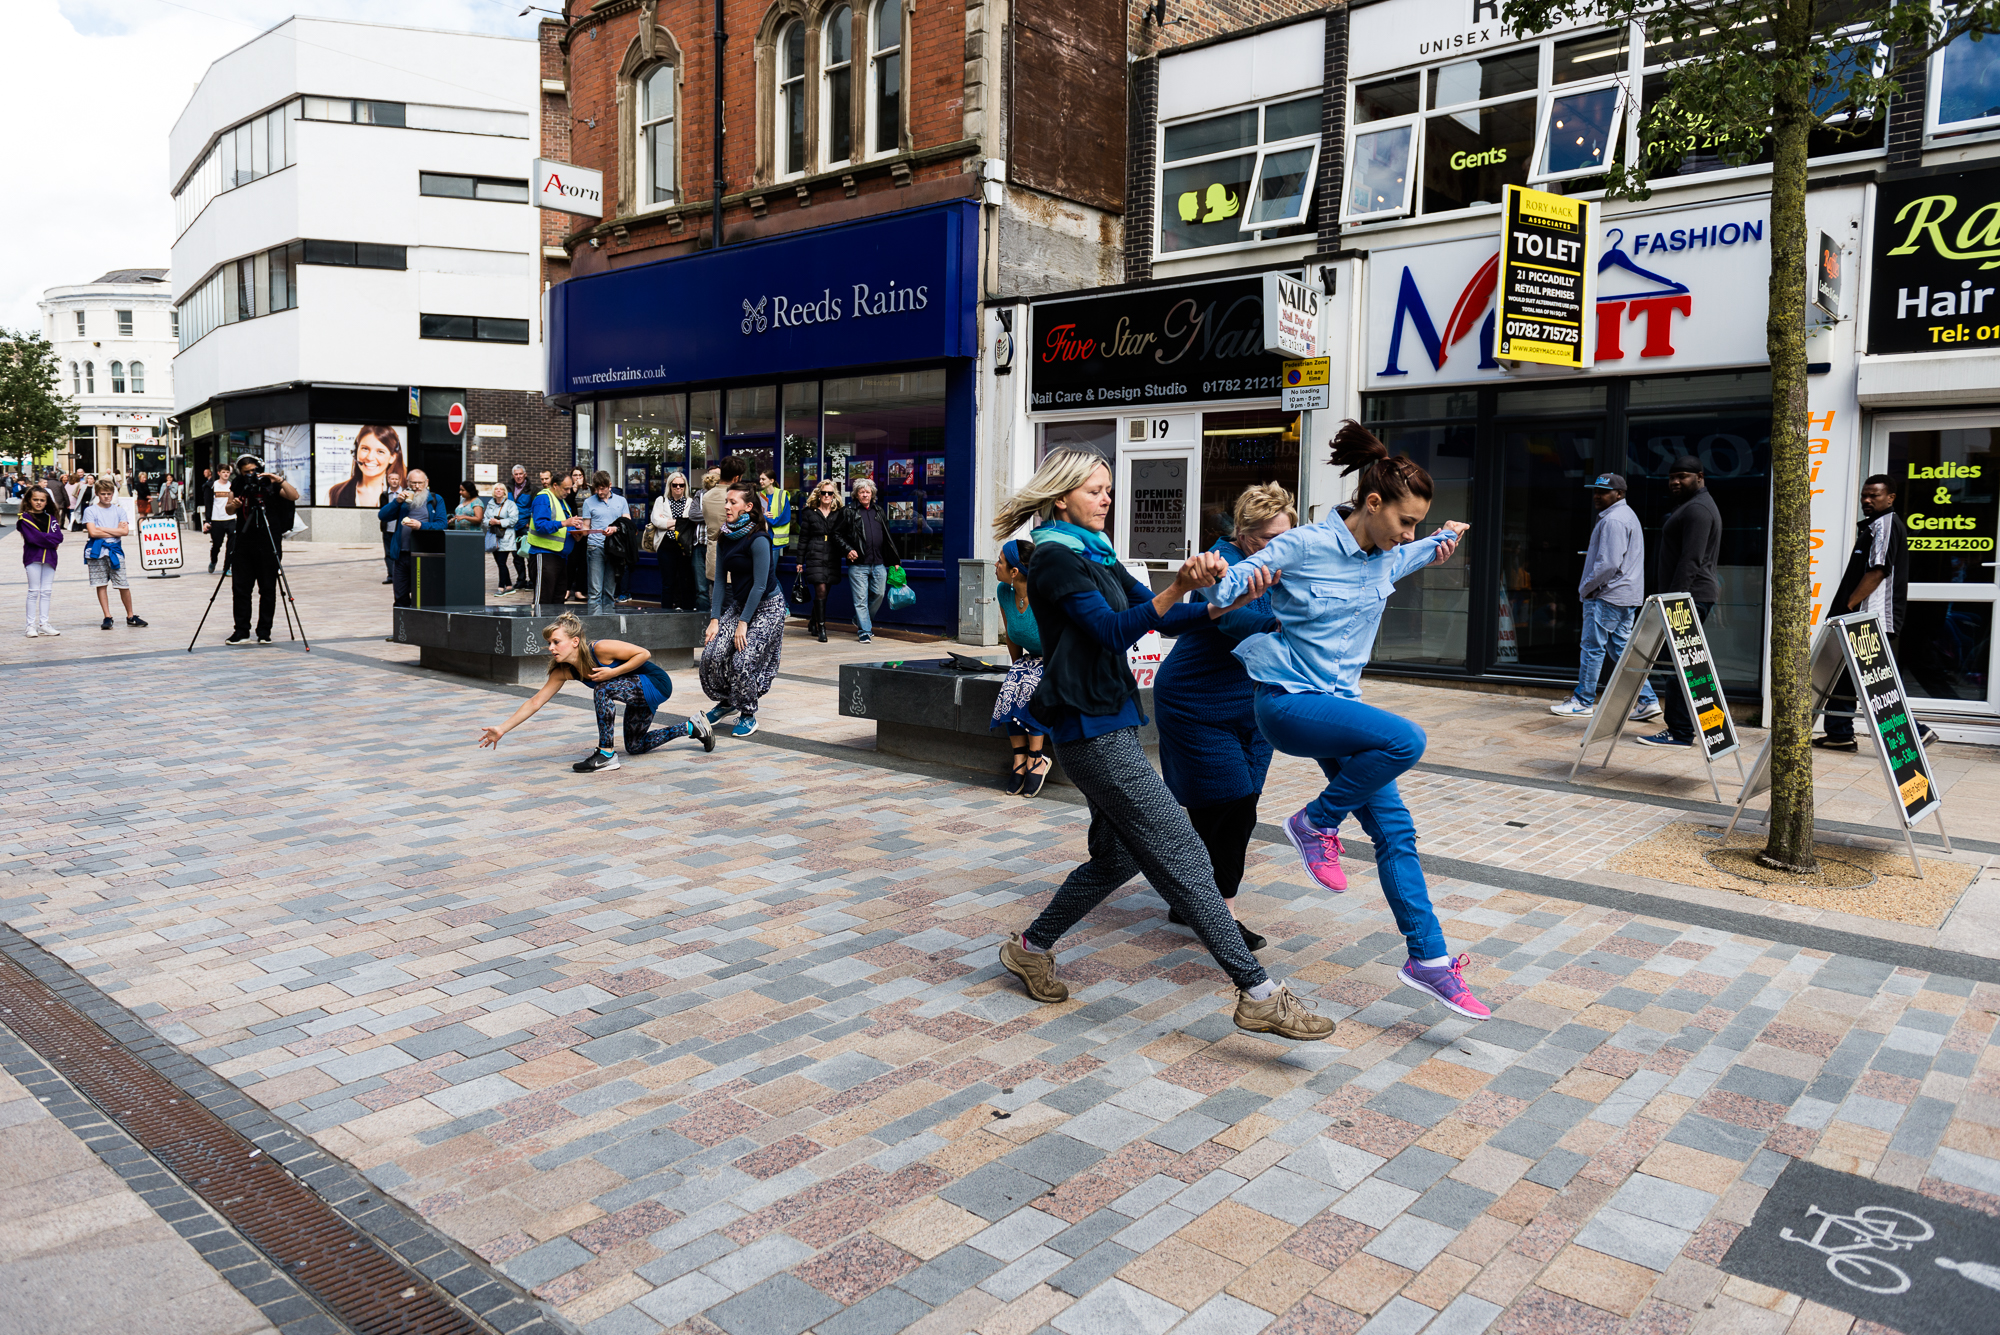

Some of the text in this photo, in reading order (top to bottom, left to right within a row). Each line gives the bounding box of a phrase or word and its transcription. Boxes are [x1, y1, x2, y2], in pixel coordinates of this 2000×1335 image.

[1420, 28, 1489, 55] UNISEX
[1450, 146, 1507, 171] Gents
[543, 173, 600, 201] Acorn
[1525, 199, 1573, 218] RORY MACK
[1528, 216, 1571, 230] ASSOCIATES
[1886, 194, 2000, 271] Ra
[1634, 219, 1763, 255] FASHION
[1513, 231, 1581, 263] TO LET
[1516, 270, 1575, 288] 21 PICCADILLY
[1278, 278, 1318, 317] NAILS
[1508, 295, 1525, 303] WOULD
[1515, 283, 1575, 300] RETAIL PREMISES
[1897, 280, 1995, 319] Hair
[772, 280, 929, 329] Reeds Rains
[1282, 308, 1294, 323] Nail
[1294, 313, 1305, 327] Bar
[1042, 323, 1096, 362] Five
[1101, 316, 1158, 358] Star
[1155, 295, 1276, 365] Nai
[1279, 319, 1299, 340] Beauty
[1506, 320, 1579, 343] 01782 715725
[1928, 324, 1970, 343] Tel:
[1513, 344, 1572, 357] WWW.RORYMACK.CO.UK
[1284, 360, 1313, 368] Pedestrian
[572, 364, 667, 385] www.reedsrains.co.uk
[1031, 375, 1282, 405] Nail Care & Design Studio 01782 21212
[1300, 387, 1320, 395] loading
[1152, 419, 1169, 439] 19
[147, 471, 160, 480] ATS
[1907, 461, 1982, 480] Ladies
[1135, 488, 1183, 499] OPENING
[1933, 486, 1952, 504] &
[1135, 499, 1183, 512] TIMES
[1135, 512, 1182, 520] MON TO SAT
[1906, 513, 1977, 530] Gents
[143, 532, 177, 541] NAILS
[1907, 538, 1991, 550] 782 214200
[145, 547, 179, 556] BEAUTY
[147, 558, 180, 566] 212124
[1666, 601, 1693, 635] Raffles
[1848, 623, 1881, 666] Raffles
[1876, 664, 1893, 681] Gents
[1878, 715, 1896, 738] pening
